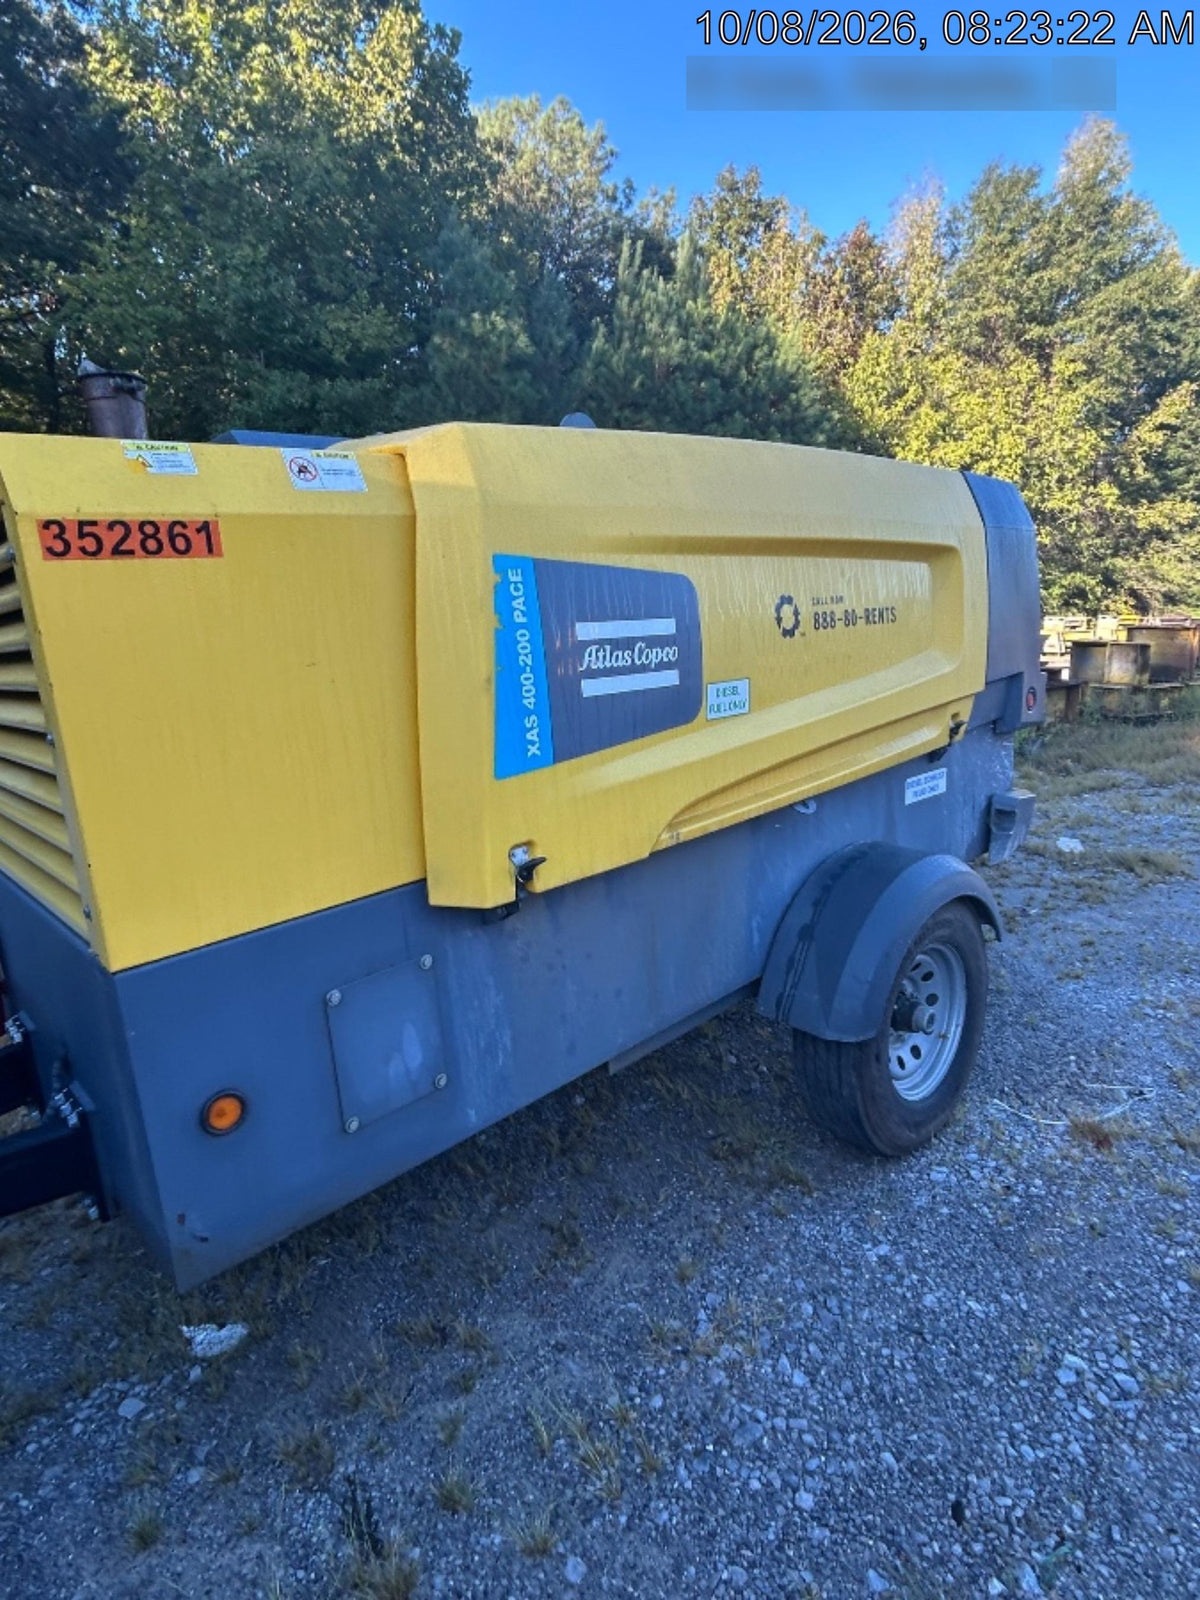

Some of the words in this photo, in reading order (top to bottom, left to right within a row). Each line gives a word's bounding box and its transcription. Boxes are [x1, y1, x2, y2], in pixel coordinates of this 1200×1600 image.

[41, 518, 217, 558] 352861
[507, 567, 527, 624] PACE
[813, 606, 897, 630] 888-80-RENTS
[513, 631, 536, 710] 400-200
[579, 644, 632, 672] Atlas
[633, 641, 679, 669] Copco
[716, 685, 740, 698] DIESEL
[525, 713, 541, 758] XAS
